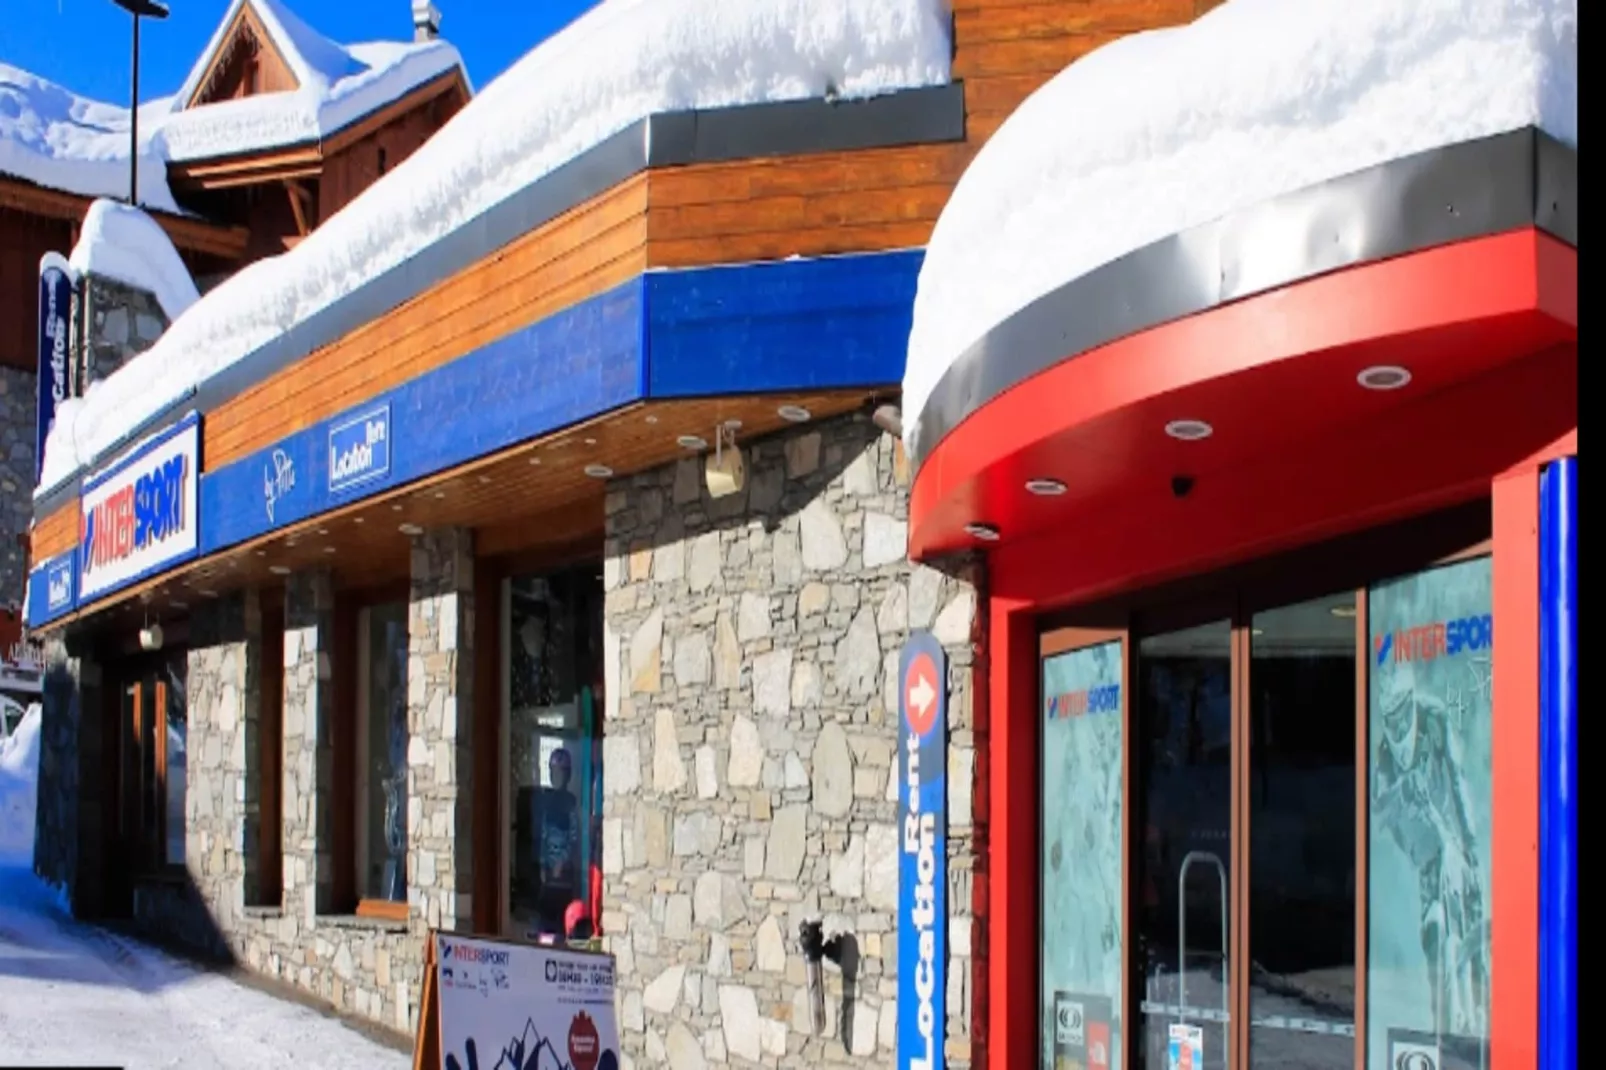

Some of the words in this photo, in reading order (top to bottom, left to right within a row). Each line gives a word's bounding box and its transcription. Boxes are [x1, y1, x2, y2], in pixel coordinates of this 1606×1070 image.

[332, 441, 372, 480] Location
[94, 450, 188, 567] INTERSPORT
[1394, 613, 1493, 664] INTERSPOR
[1058, 683, 1119, 719] INTERSPORT
[905, 733, 920, 853] Rent
[454, 944, 510, 966] INTERSPORT
[911, 811, 935, 1070] Location
